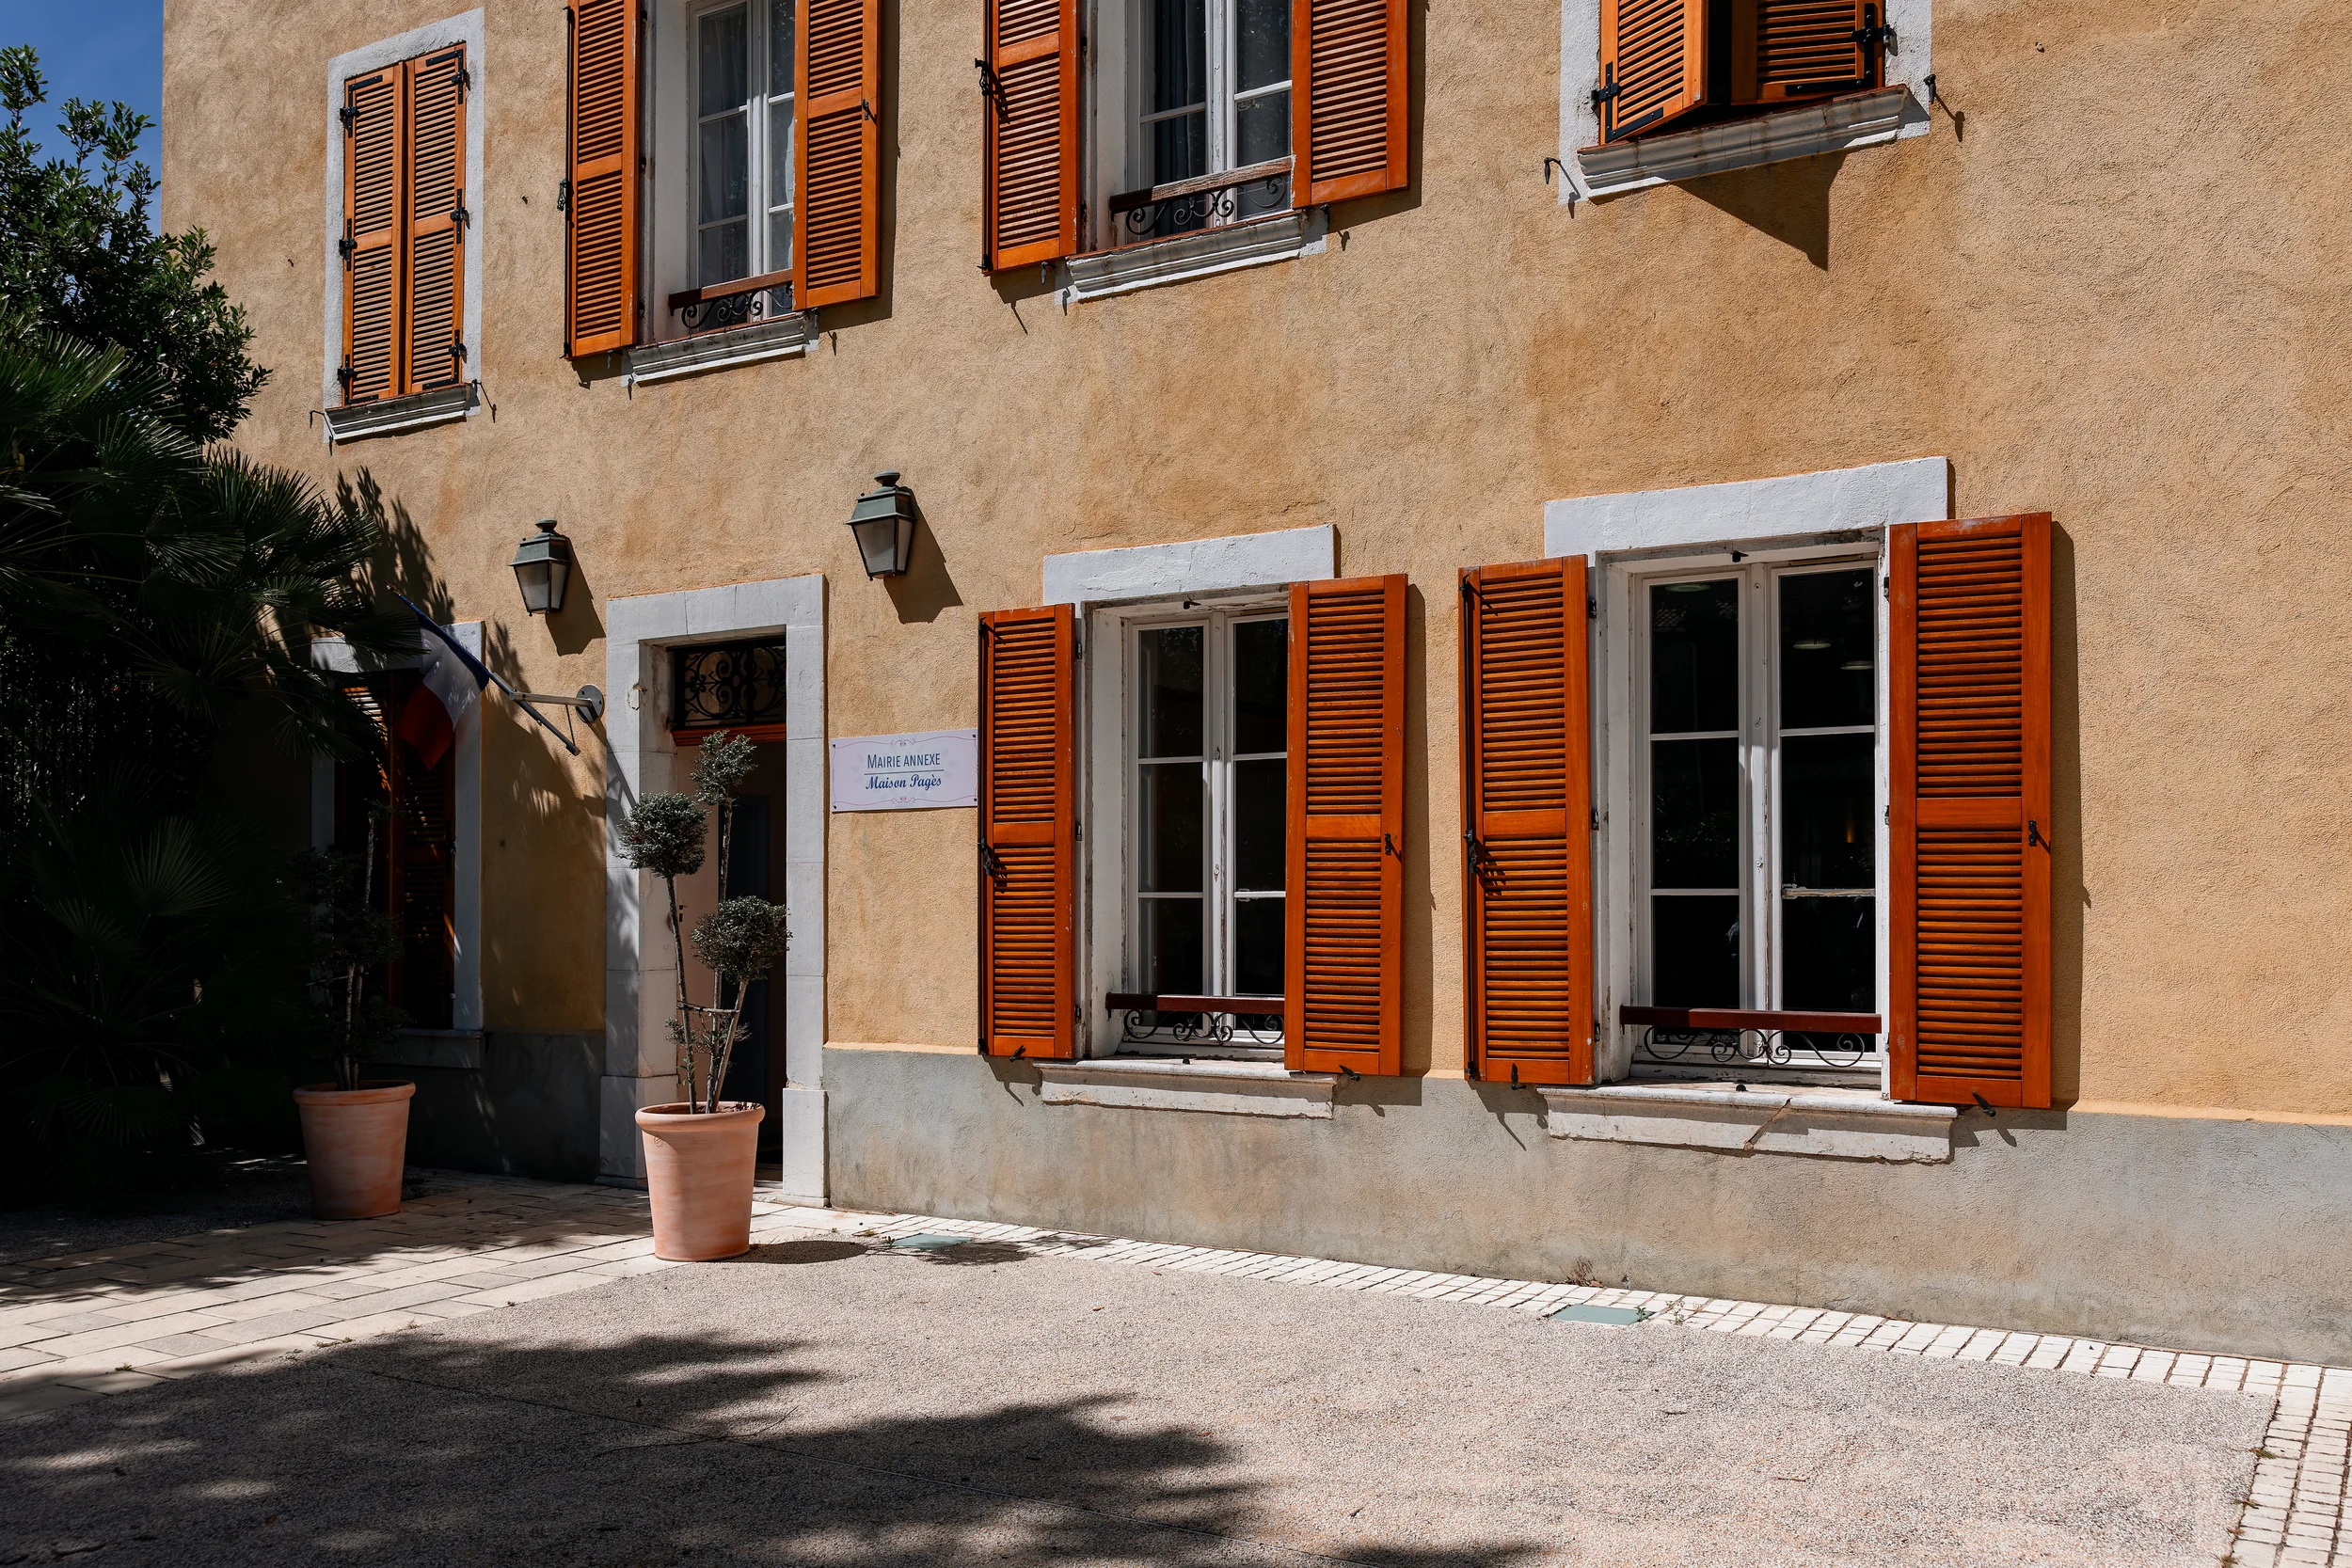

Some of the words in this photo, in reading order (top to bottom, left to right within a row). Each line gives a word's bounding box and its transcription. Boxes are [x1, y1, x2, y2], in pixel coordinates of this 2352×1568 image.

[867, 754, 901, 768] MAIRIE
[903, 753, 941, 767] ANNEXE
[866, 776, 907, 789] Maison
[910, 774, 942, 791] Pagès
